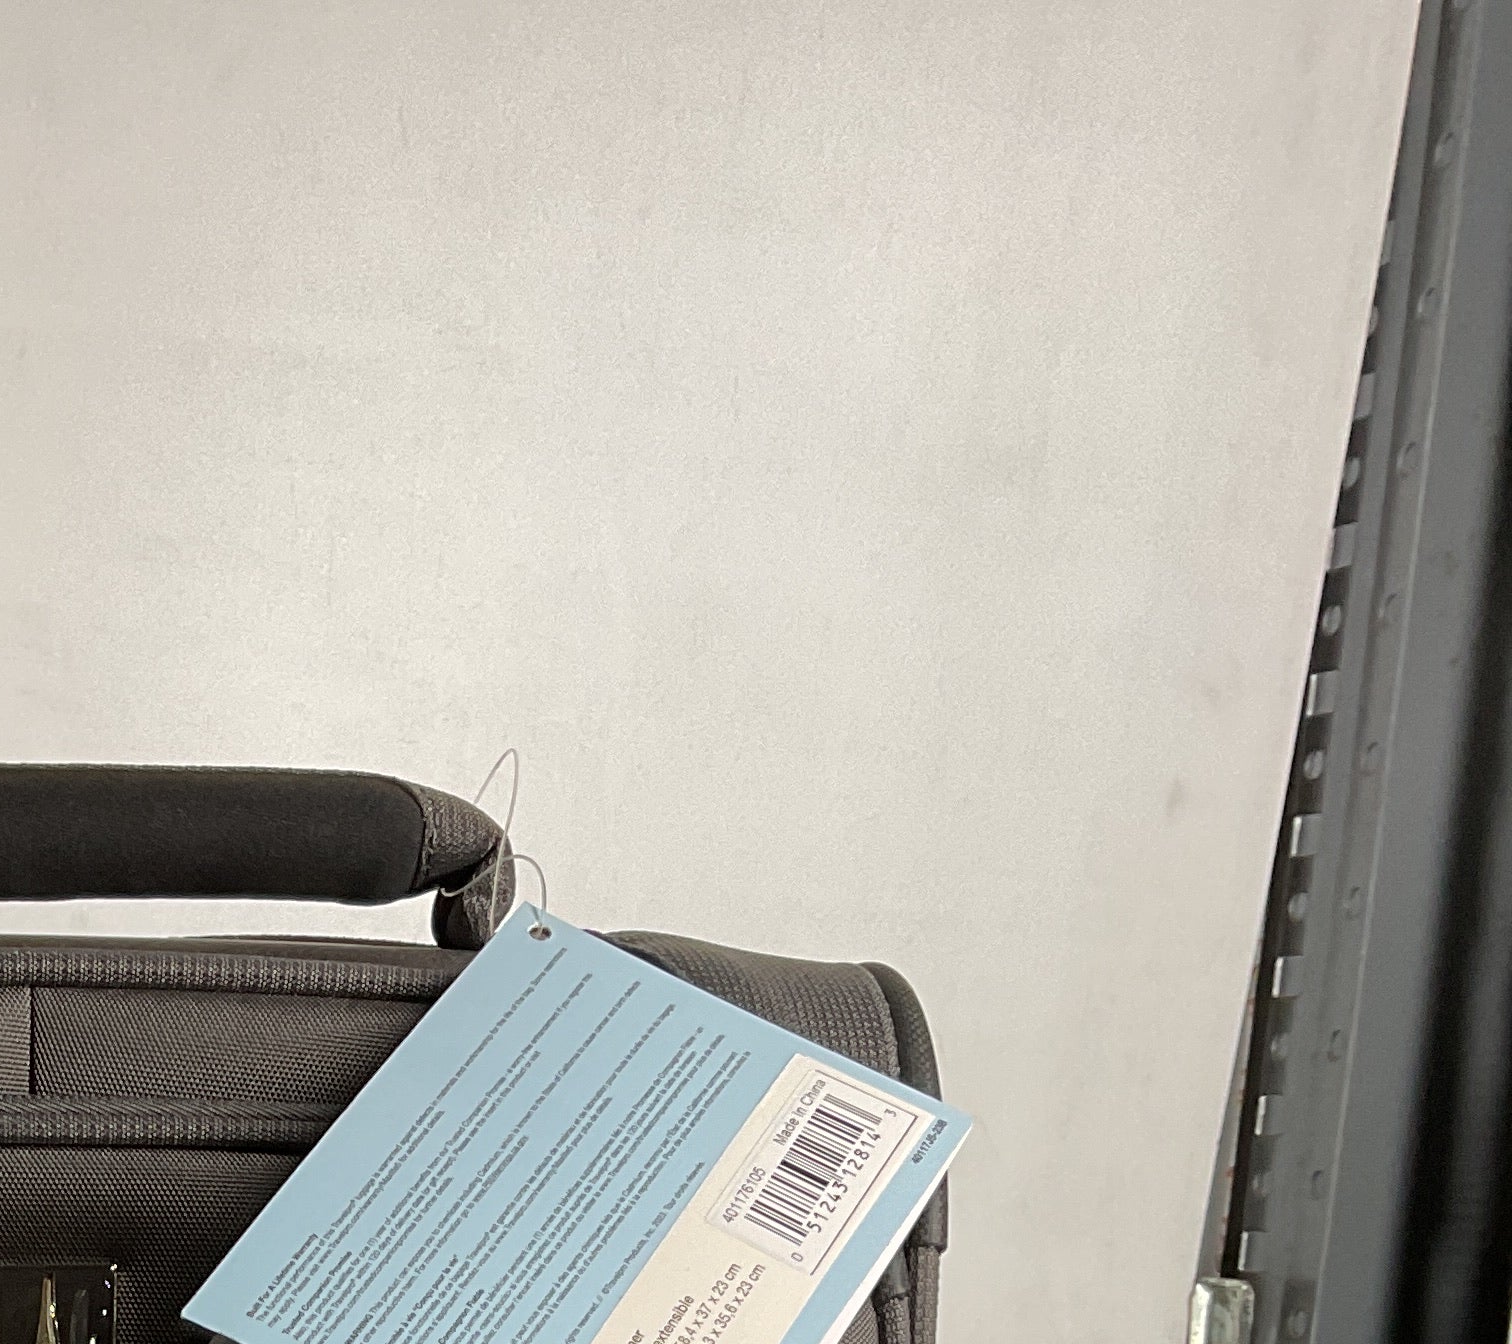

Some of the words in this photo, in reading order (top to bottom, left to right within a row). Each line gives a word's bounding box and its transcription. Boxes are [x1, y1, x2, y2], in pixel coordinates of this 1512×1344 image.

[723, 1167, 765, 1222] 401176105
[773, 1118, 798, 1145] Made
[800, 1080, 825, 1105] China
[806, 1179, 849, 1234] 51243
[841, 1129, 881, 1178] 12814
[696, 1303, 710, 1318] 37
[712, 1281, 728, 1295] 23
[725, 1264, 740, 1280] cm
[714, 1304, 736, 1328] 35,6
[737, 1281, 752, 1296] 23
[749, 1265, 764, 1280] cm
